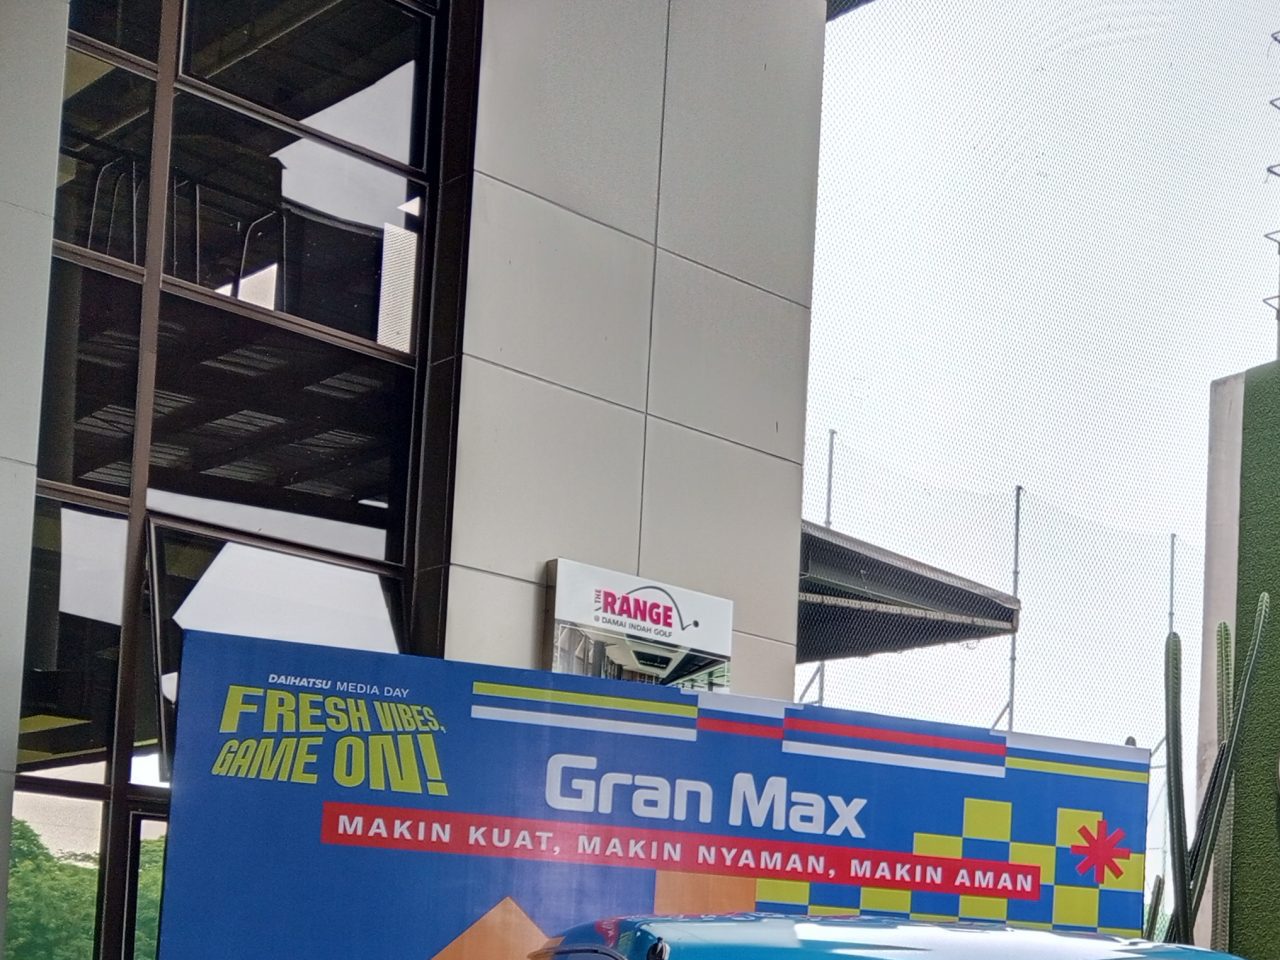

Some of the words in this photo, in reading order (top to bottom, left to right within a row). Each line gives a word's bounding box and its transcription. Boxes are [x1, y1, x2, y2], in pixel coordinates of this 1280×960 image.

[602, 591, 673, 628] RANGE
[219, 685, 371, 733] FRESH
[374, 700, 447, 733] VIBES,
[268, 674, 332, 689] DAIHATSU
[336, 681, 379, 695] MEDIA
[384, 687, 410, 698] DAY
[211, 736, 323, 784] GAME
[333, 733, 448, 796] ON!
[545, 753, 713, 823] Gran
[728, 772, 867, 838] Max
[337, 815, 450, 843] MAKIN
[468, 826, 560, 855] KUAT,
[577, 835, 681, 861] MAKIN
[697, 846, 836, 878] NYAMAN,
[850, 859, 943, 884] MAKIN
[954, 869, 1033, 892] AMAN
